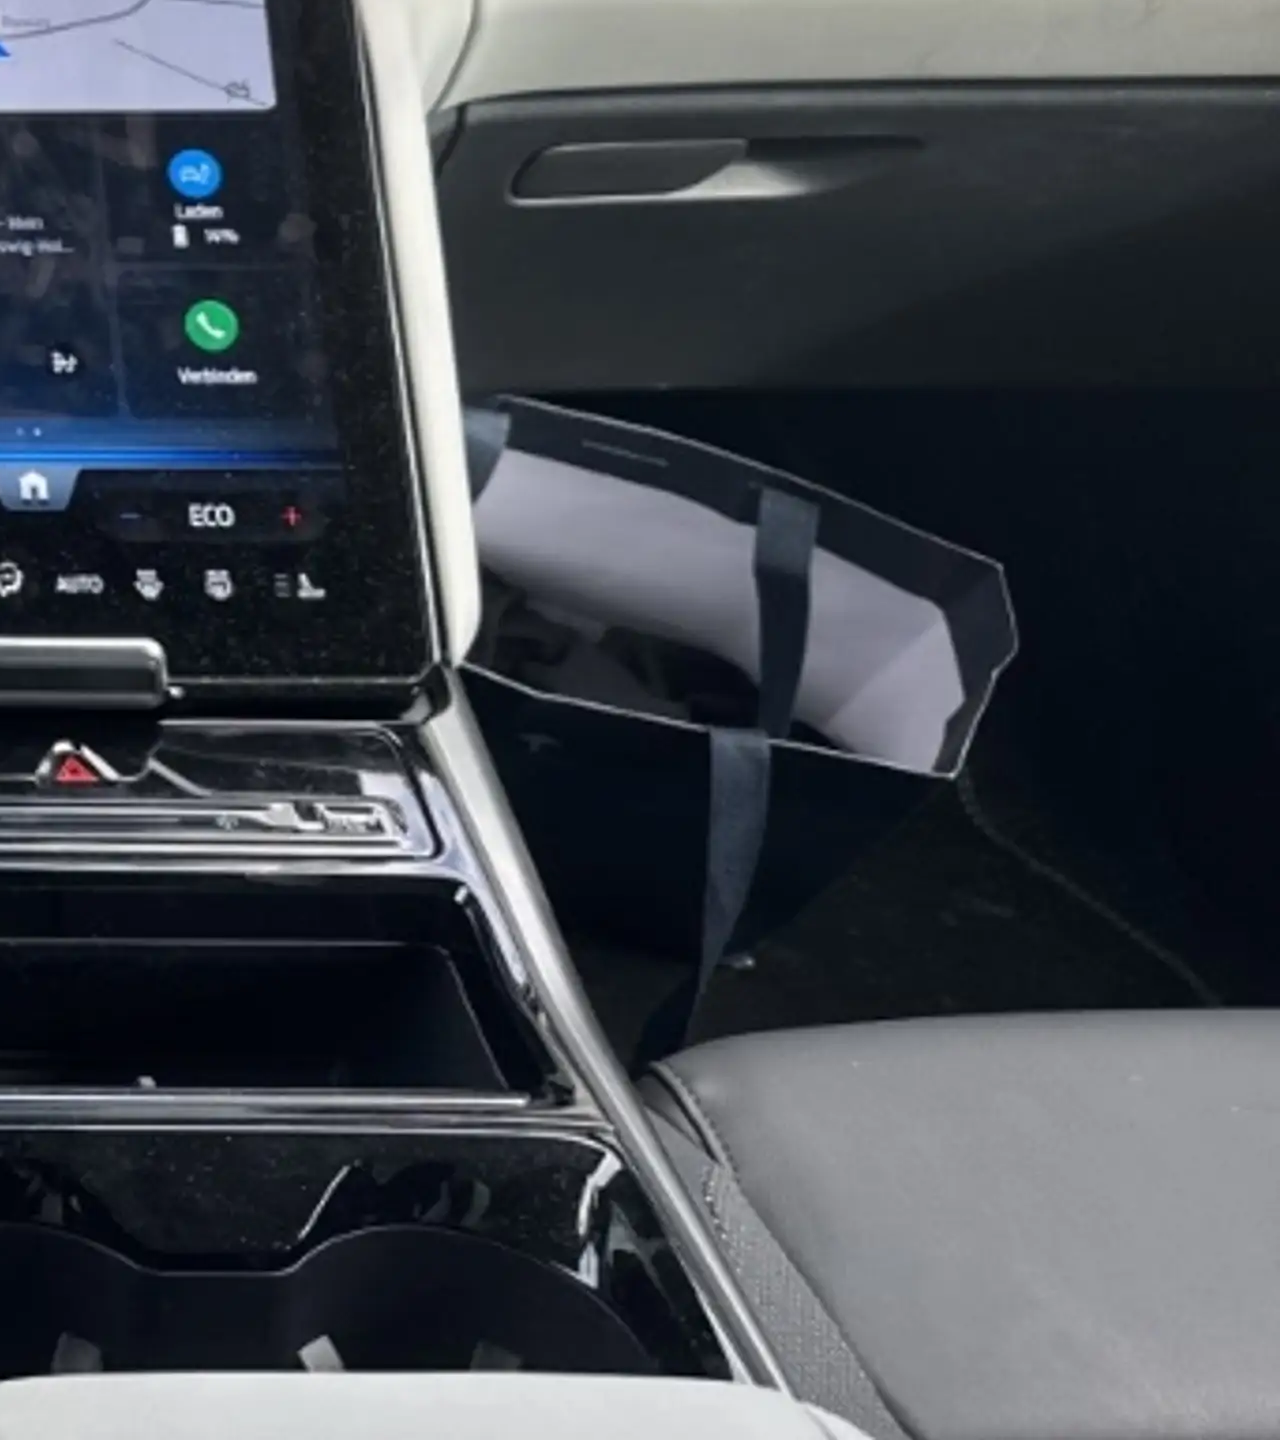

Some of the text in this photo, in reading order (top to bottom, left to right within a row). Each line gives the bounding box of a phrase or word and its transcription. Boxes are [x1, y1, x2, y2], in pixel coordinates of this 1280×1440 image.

[174, 202, 224, 221] Laden
[177, 366, 258, 386] Verbinden
[187, 503, 237, 529] ECO
[54, 573, 106, 595] AUTO
